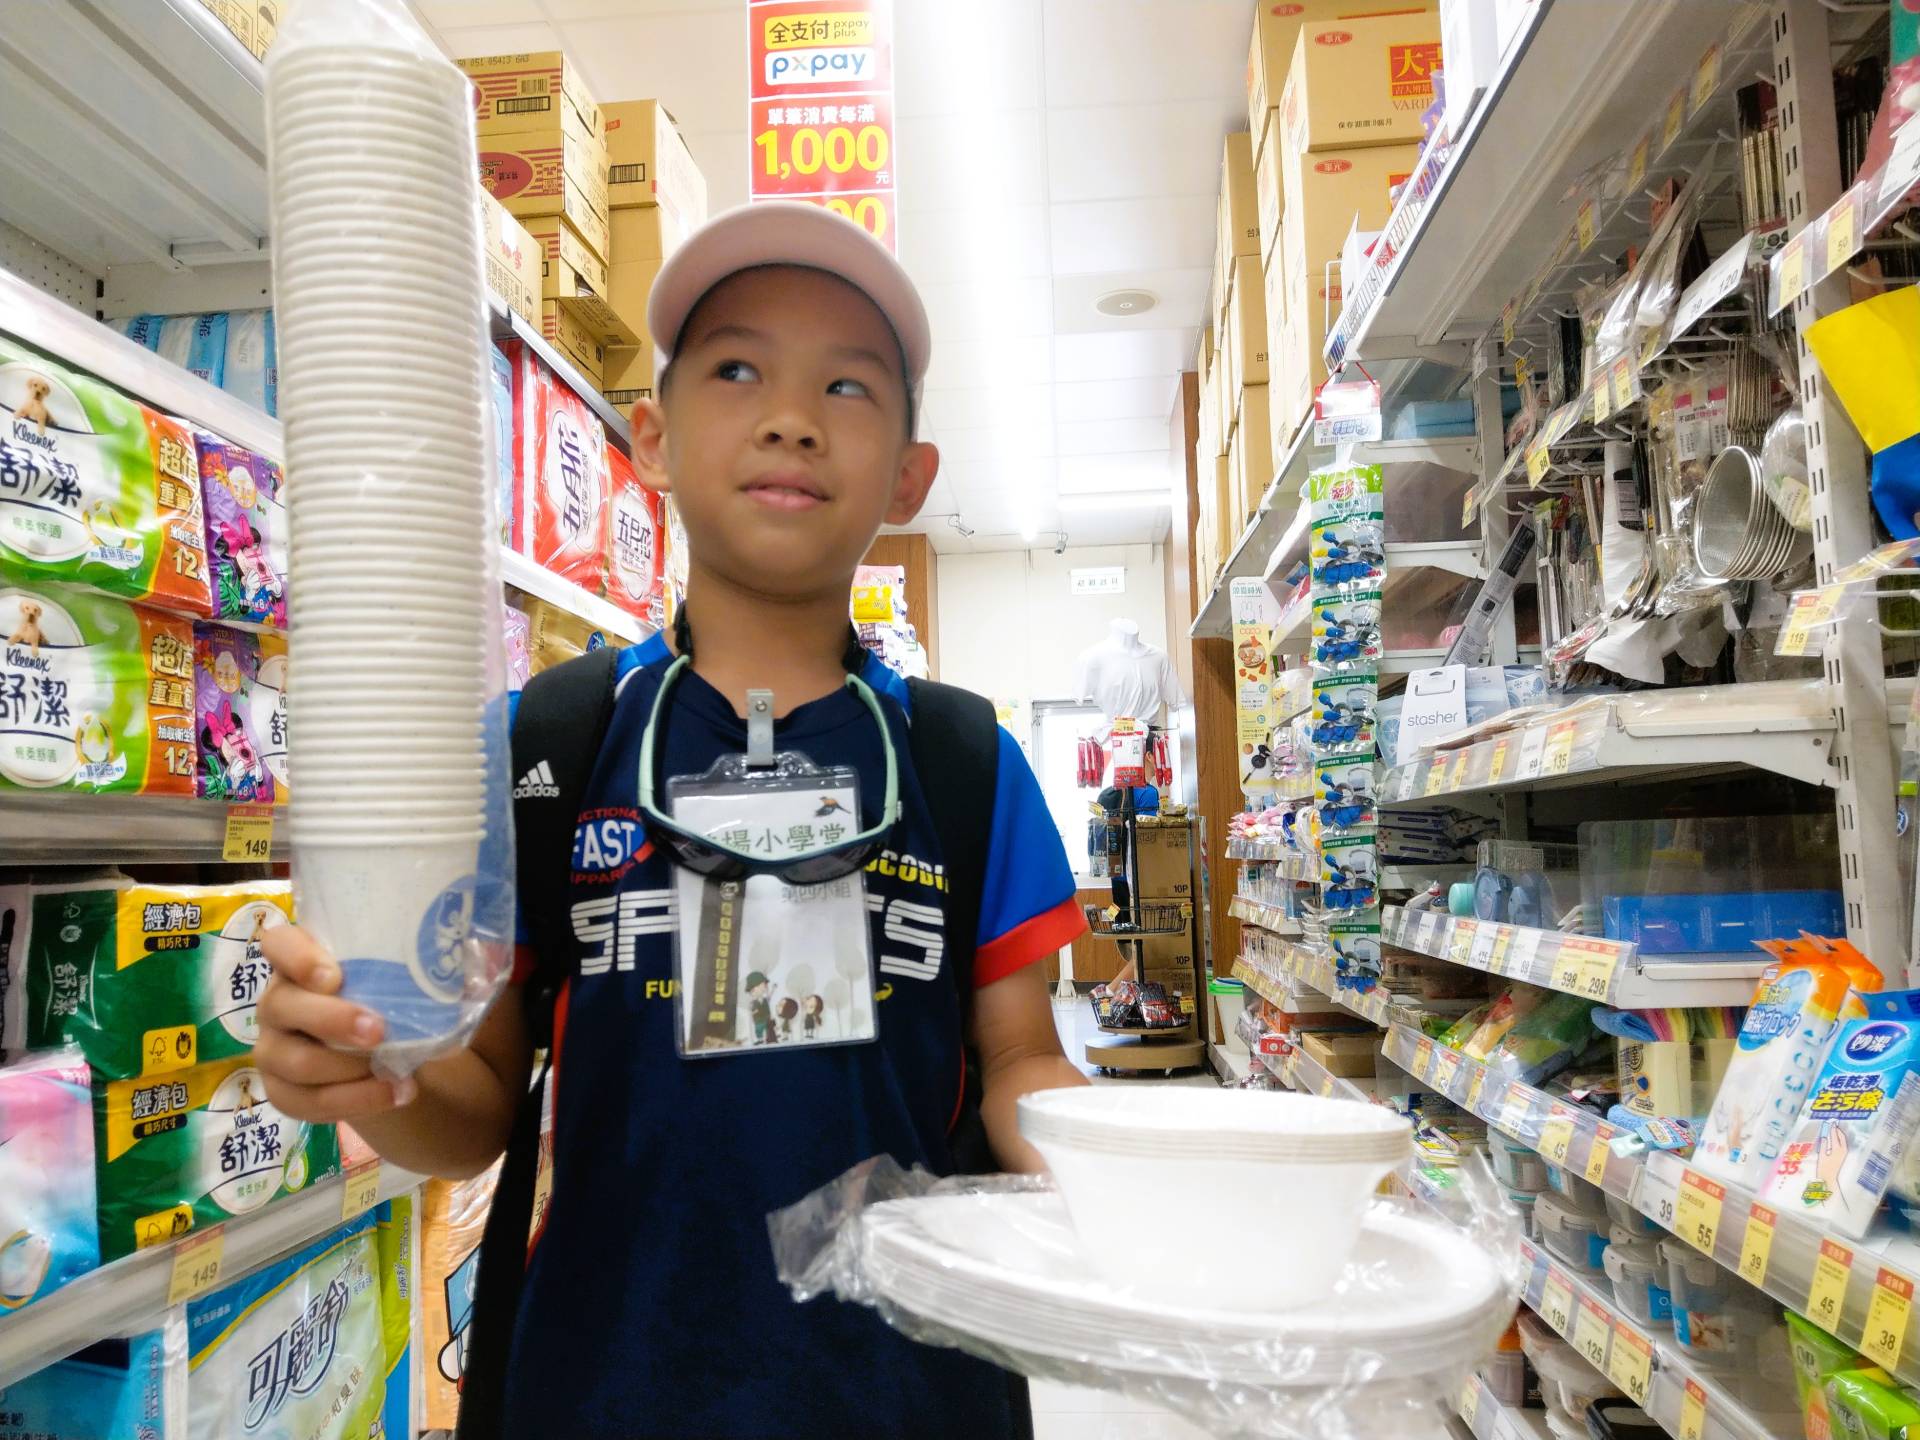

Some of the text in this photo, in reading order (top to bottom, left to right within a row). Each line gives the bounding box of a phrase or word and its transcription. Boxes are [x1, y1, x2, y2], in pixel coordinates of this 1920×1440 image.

[769, 20, 830, 44] 全支付
[834, 20, 870, 31] pxpay
[834, 29, 857, 39] plus
[772, 52, 867, 80] pxpay
[767, 104, 875, 126] 單筆消費每滿
[755, 125, 889, 180] 1,000
[875, 171, 890, 185] 元
[13, 420, 58, 452] Kleenex
[172, 546, 199, 579] 12
[6, 647, 51, 674] Kleenex
[1407, 711, 1458, 727] stasher
[513, 785, 559, 799] adidas
[245, 839, 268, 857] 149
[144, 901, 201, 932] 經濟包
[131, 1081, 188, 1120] 經濟包
[218, 1123, 282, 1173] 舒潔
[1659, 1199, 1673, 1222] 39
[1697, 1223, 1713, 1249] 55
[192, 1262, 218, 1288] 149
[1820, 1296, 1834, 1314] 45
[1552, 1307, 1566, 1330] 139
[245, 1258, 352, 1430] 可麗舒
[1586, 1340, 1603, 1364] 125
[1880, 1330, 1896, 1351] 38
